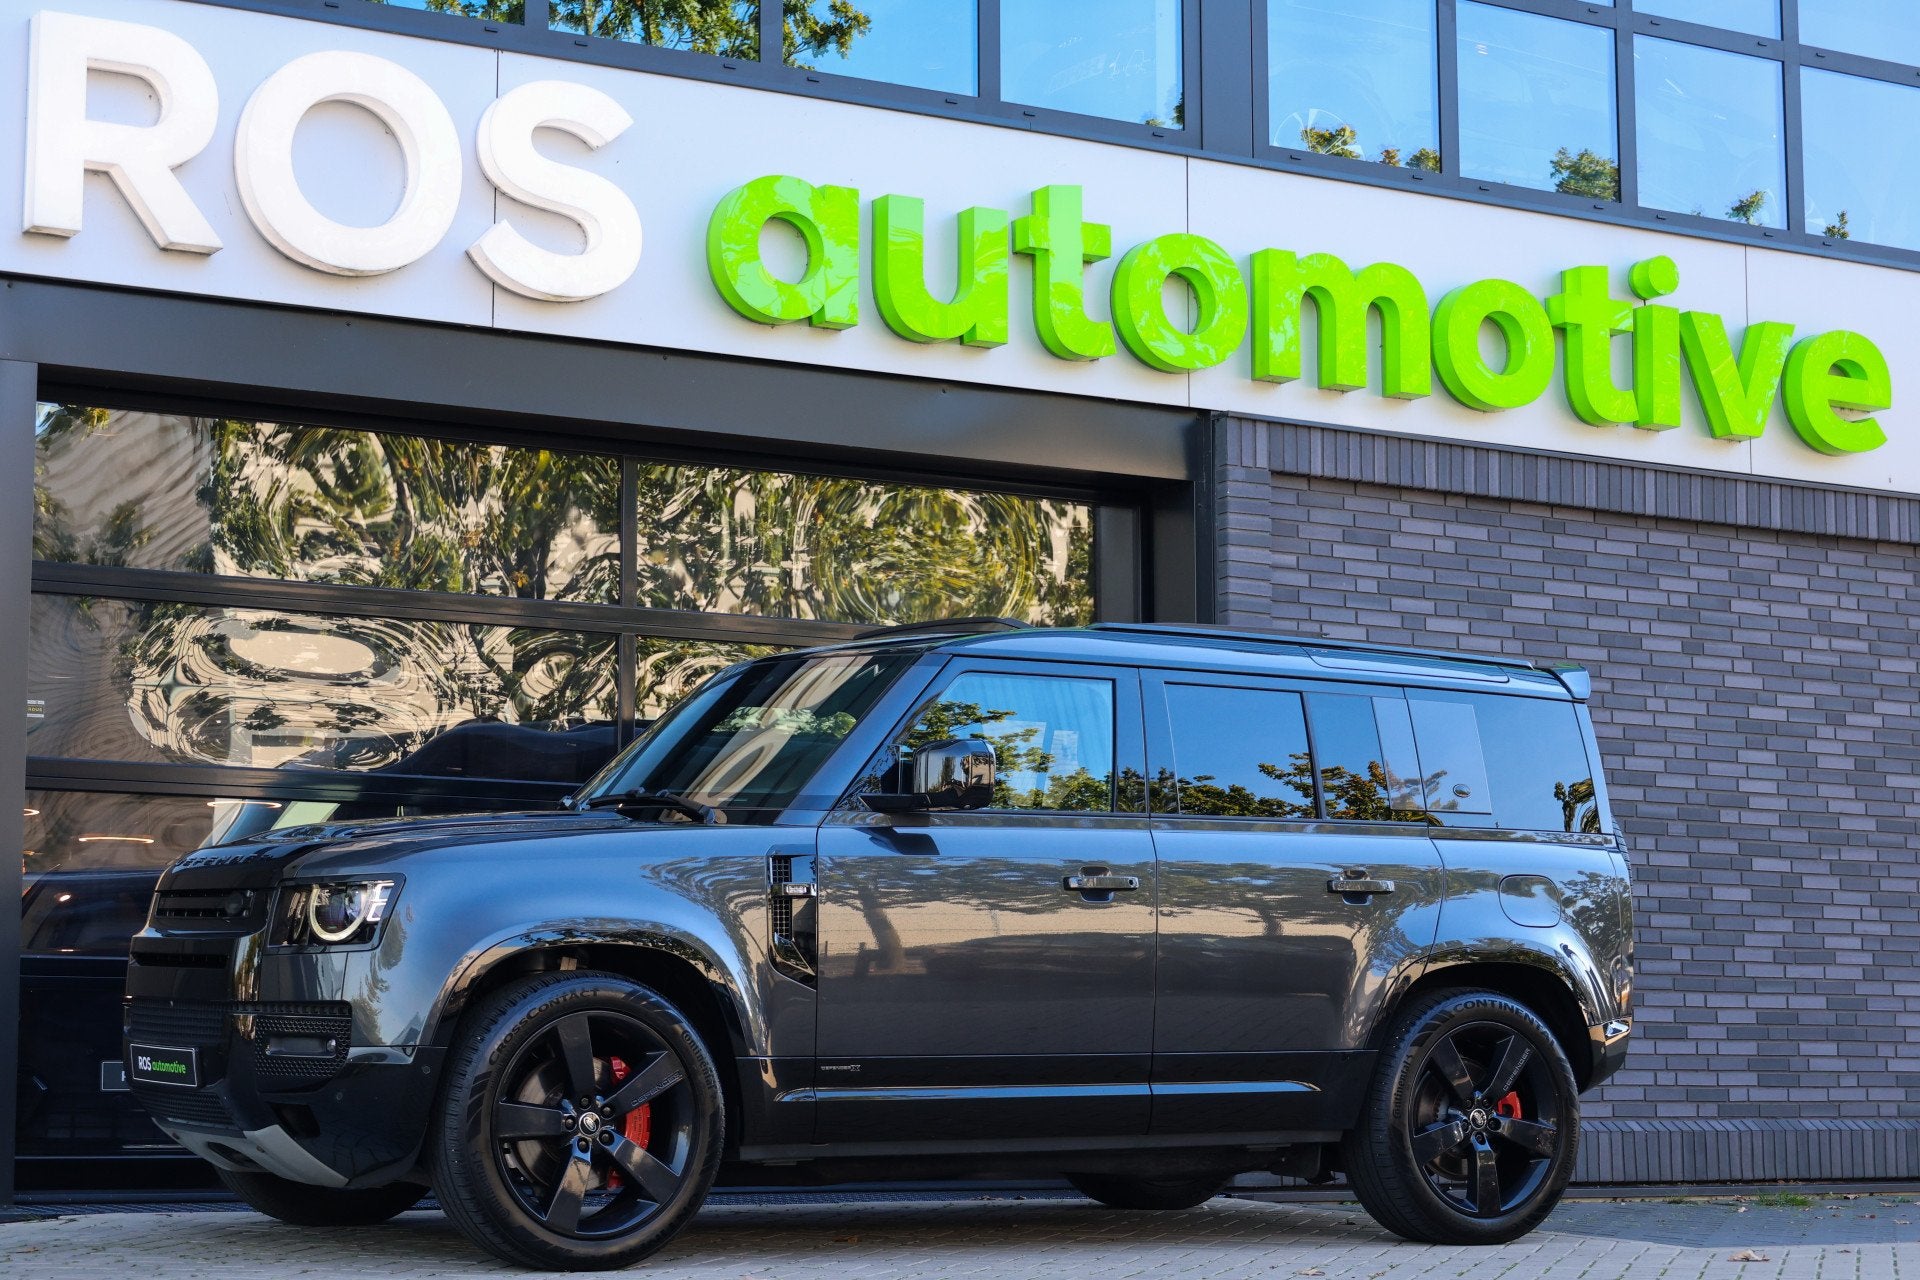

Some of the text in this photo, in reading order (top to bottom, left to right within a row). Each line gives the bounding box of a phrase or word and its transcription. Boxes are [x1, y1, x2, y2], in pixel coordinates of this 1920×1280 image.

[22, 10, 1892, 456] ROS automotive
[138, 1055, 187, 1074] ROS automotive
